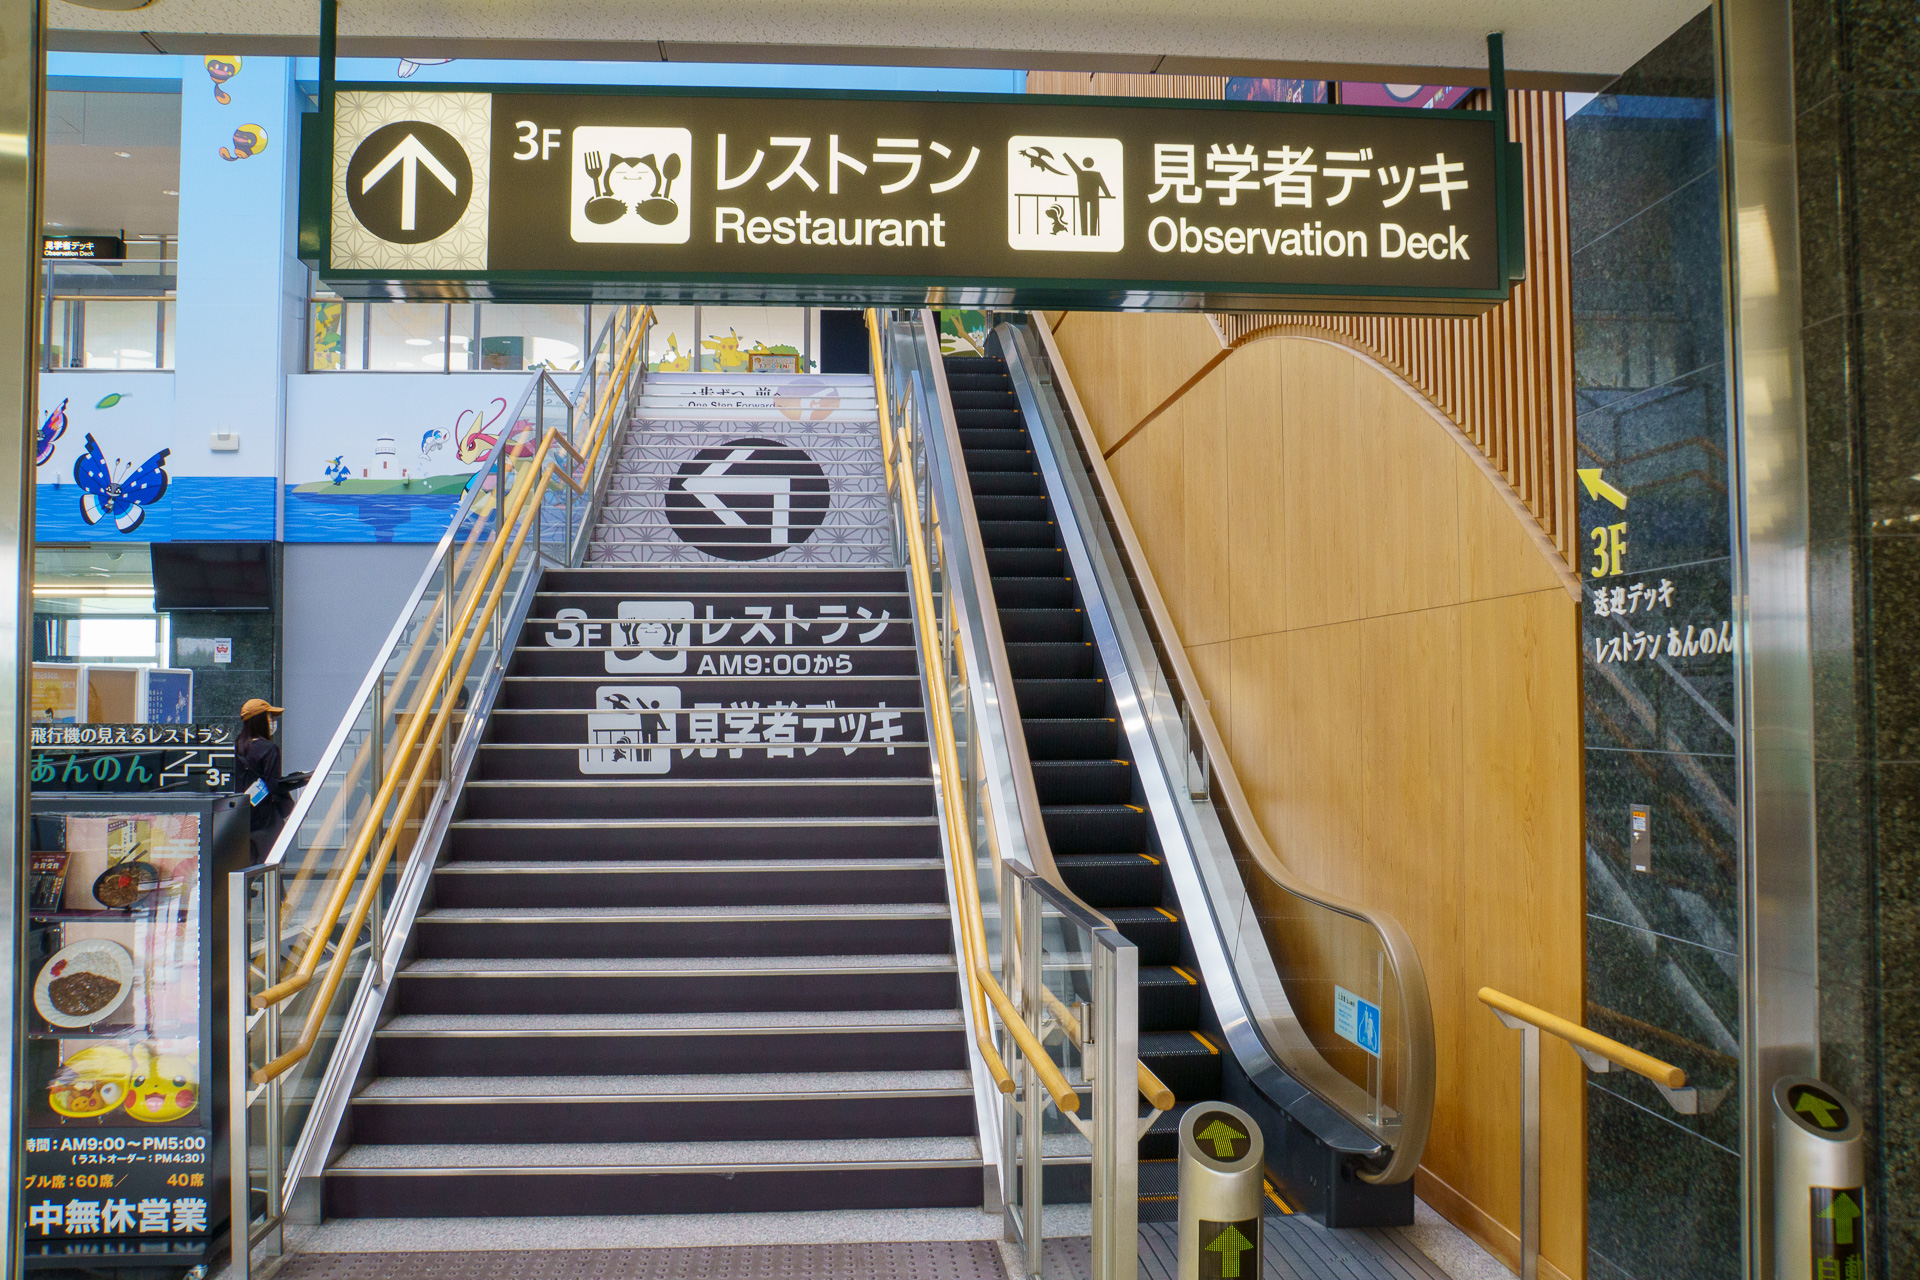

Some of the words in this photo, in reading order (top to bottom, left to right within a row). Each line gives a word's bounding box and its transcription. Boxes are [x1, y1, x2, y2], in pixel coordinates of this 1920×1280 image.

[513, 120, 561, 161] 3F
[716, 133, 980, 195] レストラン
[1148, 143, 1469, 210] 見学者デッキ
[44, 241, 95, 251] 見学者デッキ
[715, 207, 946, 247] Restaurant
[1148, 216, 1368, 257] Observation
[1380, 223, 1471, 260] Deck
[1591, 522, 1627, 578] 3F
[1594, 578, 1675, 618] 送迎デッキ
[545, 608, 601, 647] 3F
[702, 604, 891, 645] レストラン
[1596, 631, 1662, 664] レストラン
[1667, 620, 1733, 657] あんのん
[697, 654, 853, 675] AM9:00から
[31, 727, 230, 744] 飛行機の見えるレストラン
[681, 701, 903, 759] 見学者デッキ
[31, 753, 153, 783] あんのん
[206, 768, 231, 786] 3F
[167, 1173, 205, 1187] 40席
[24, 1197, 208, 1235] 中無休営業
